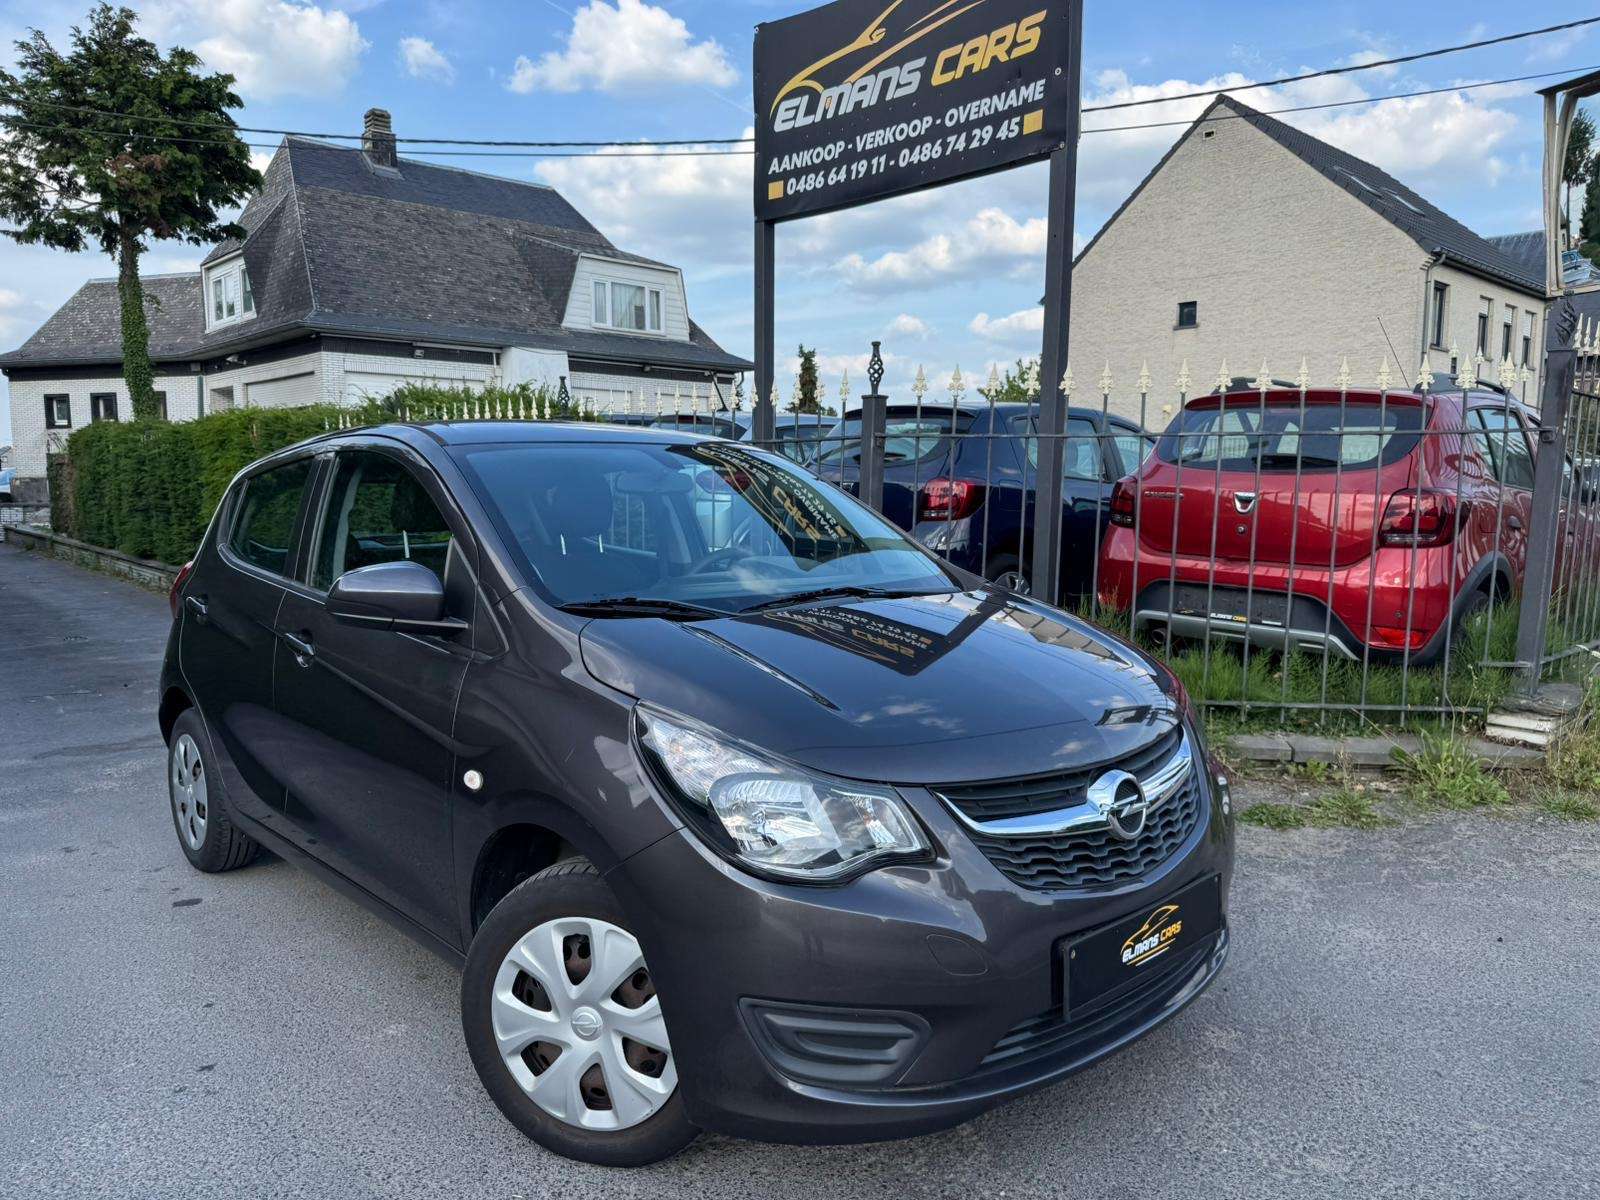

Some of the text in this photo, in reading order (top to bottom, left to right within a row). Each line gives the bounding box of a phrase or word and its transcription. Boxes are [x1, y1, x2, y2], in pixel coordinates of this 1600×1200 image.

[773, 10, 1047, 132] ELMANS CARS
[768, 141, 844, 174] AANKOOP
[856, 116, 931, 151] VERKOOP
[945, 79, 1046, 127] OVERNAME
[786, 176, 824, 195] 0486
[828, 169, 846, 184] 64
[851, 162, 866, 181] 19
[872, 157, 886, 175] 11
[899, 144, 942, 167] 0486
[945, 136, 966, 155] 74
[968, 125, 993, 150] 29
[997, 118, 1020, 141] 45
[1122, 921, 1182, 963] ELMANS CARS
